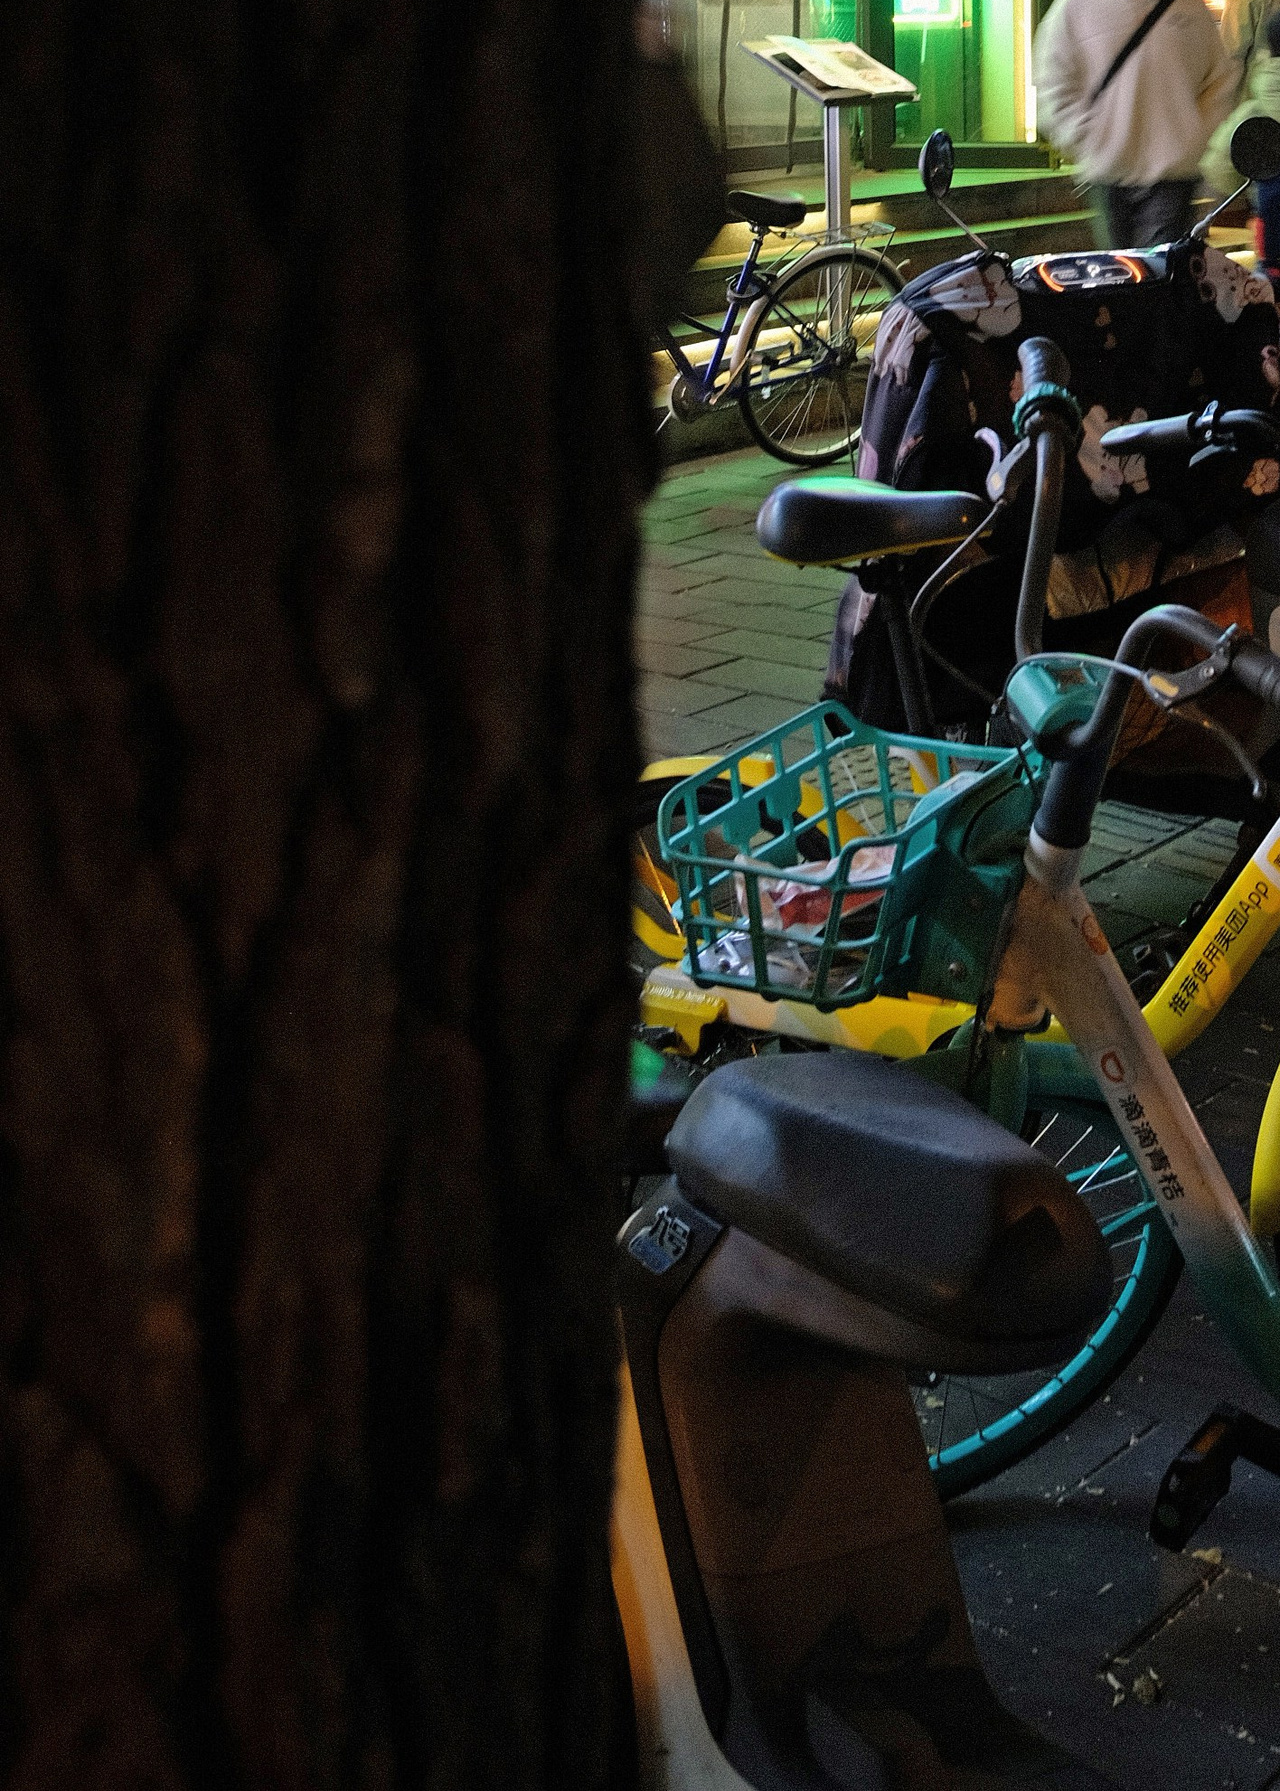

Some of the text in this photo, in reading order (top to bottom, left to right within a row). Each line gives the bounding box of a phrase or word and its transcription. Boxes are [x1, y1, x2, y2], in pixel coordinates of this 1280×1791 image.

[1168, 881, 1268, 1017] 推荐使用美团App
[1119, 1094, 1185, 1201] 滴滴青桔
